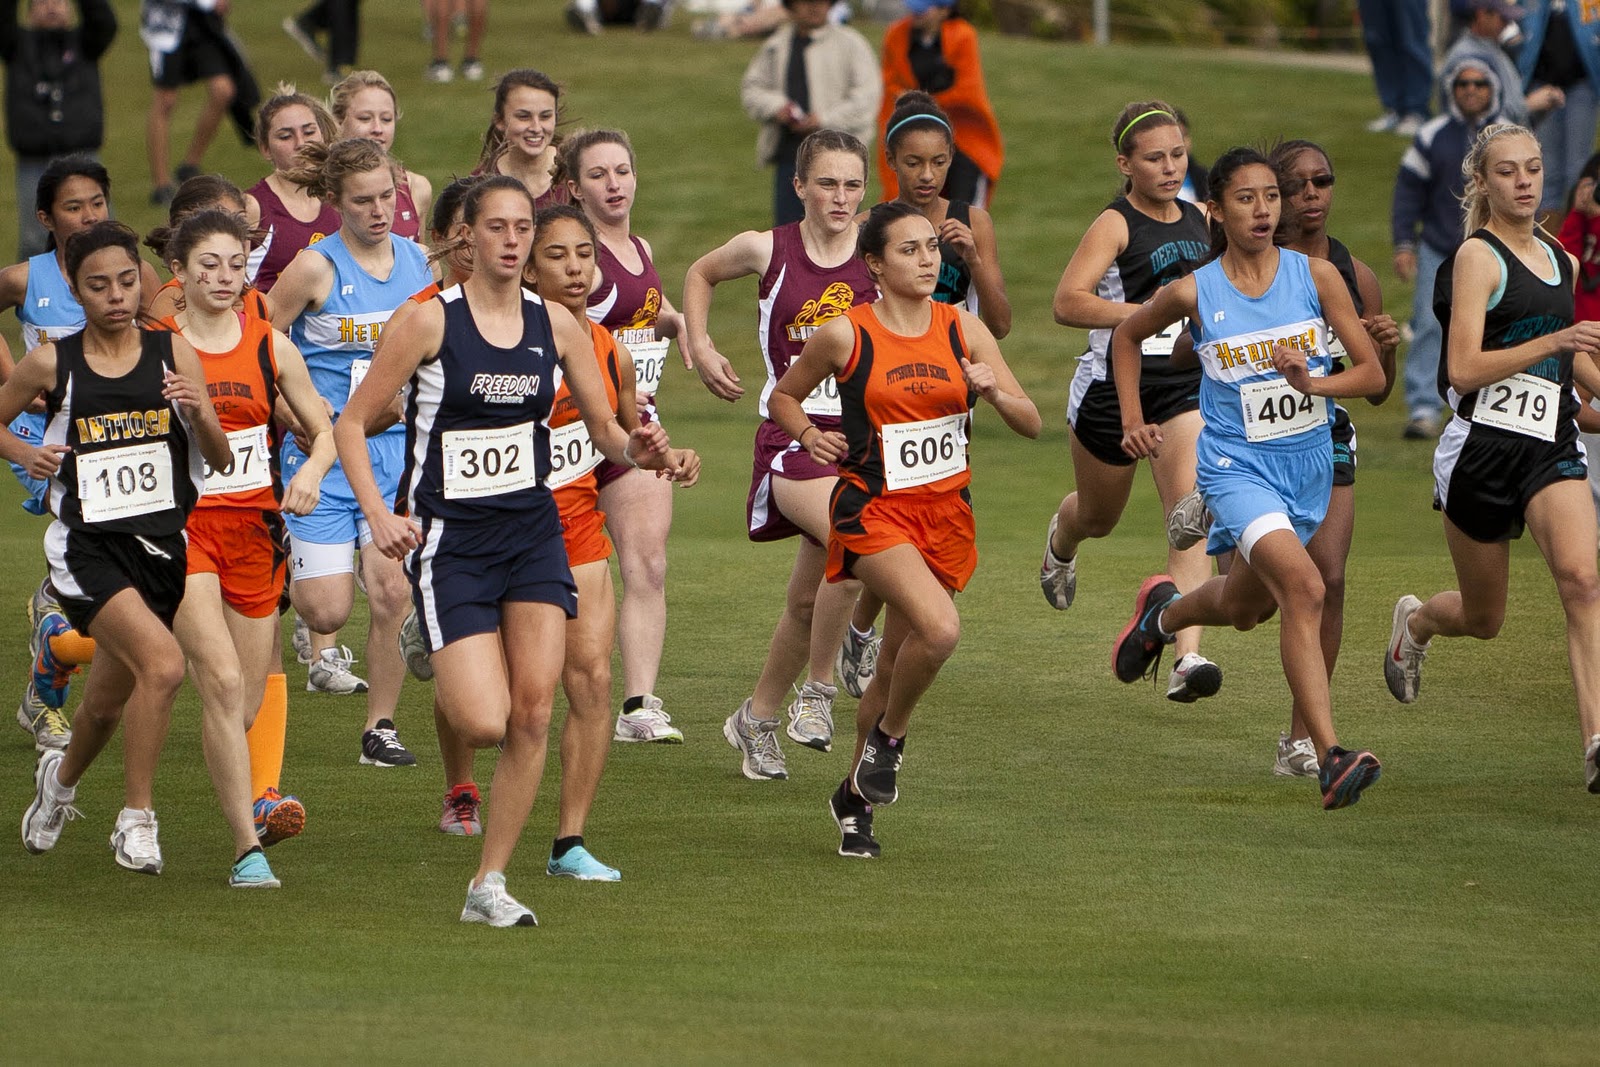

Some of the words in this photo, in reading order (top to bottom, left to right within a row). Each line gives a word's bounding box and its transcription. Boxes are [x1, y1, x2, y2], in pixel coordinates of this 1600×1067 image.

[1150, 241, 1180, 276] DEER
[470, 373, 540, 396] FREEDOM
[1258, 393, 1315, 425] 404
[1490, 385, 1547, 422] 219
[76, 407, 170, 444] ANTIOCH
[460, 443, 520, 479] 302
[900, 432, 954, 469] 606
[95, 461, 158, 499] 108
